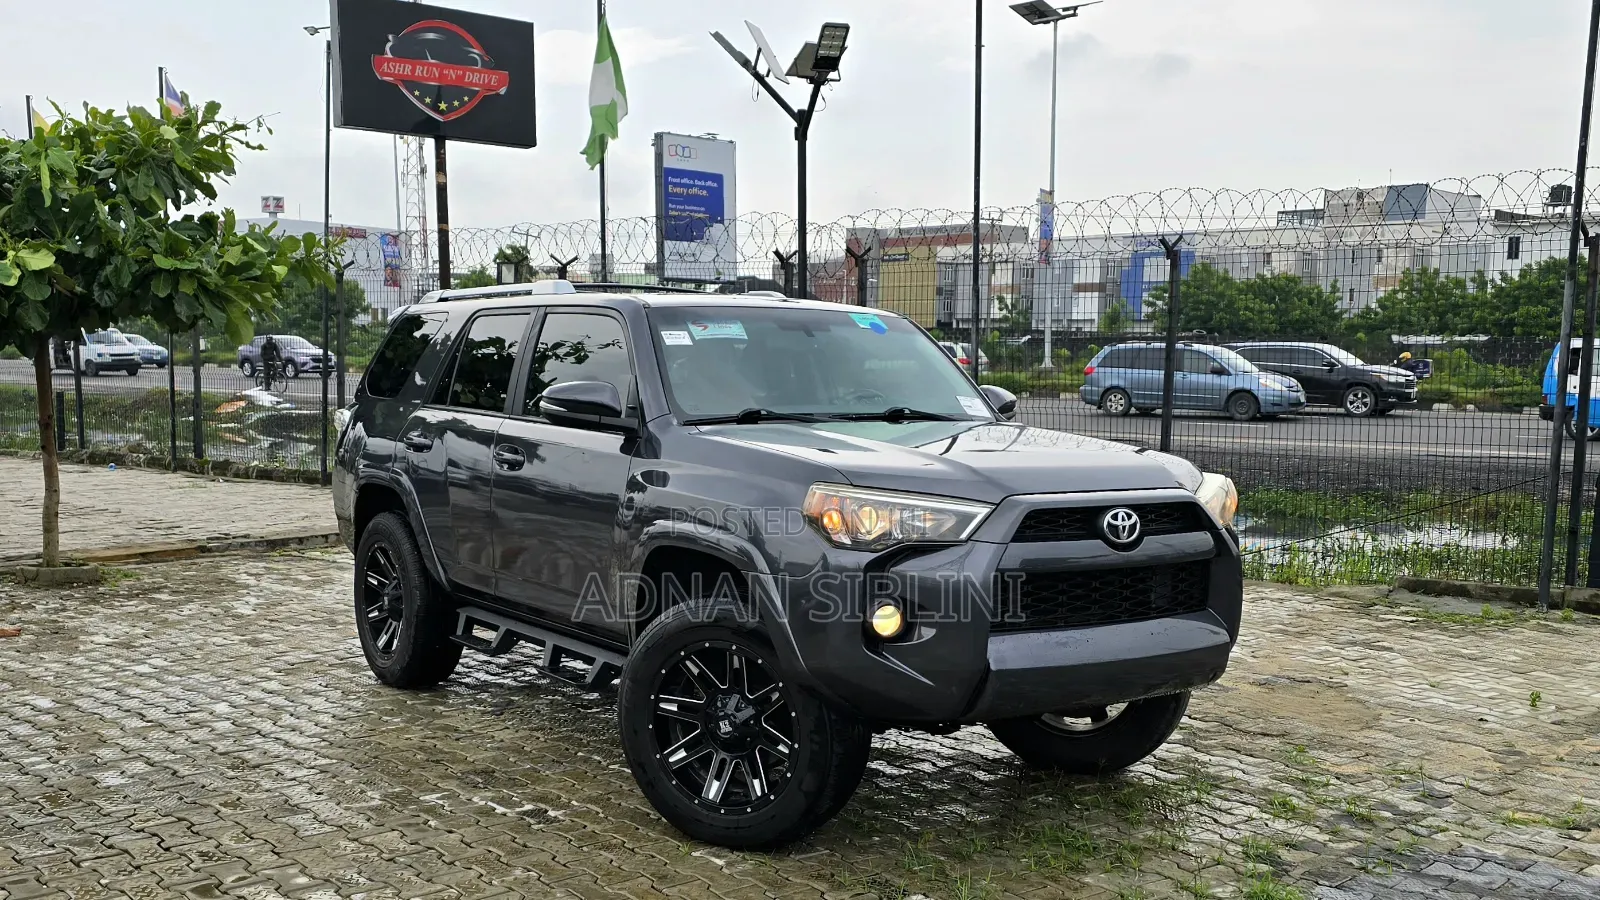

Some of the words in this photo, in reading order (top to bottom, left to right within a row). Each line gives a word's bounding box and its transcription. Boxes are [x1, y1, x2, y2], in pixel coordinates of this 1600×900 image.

[380, 62, 412, 76] ASHR
[414, 65, 440, 78] RUN
[464, 71, 499, 86] DRIVE
[668, 185, 688, 196] Every
[688, 187, 708, 196] office.
